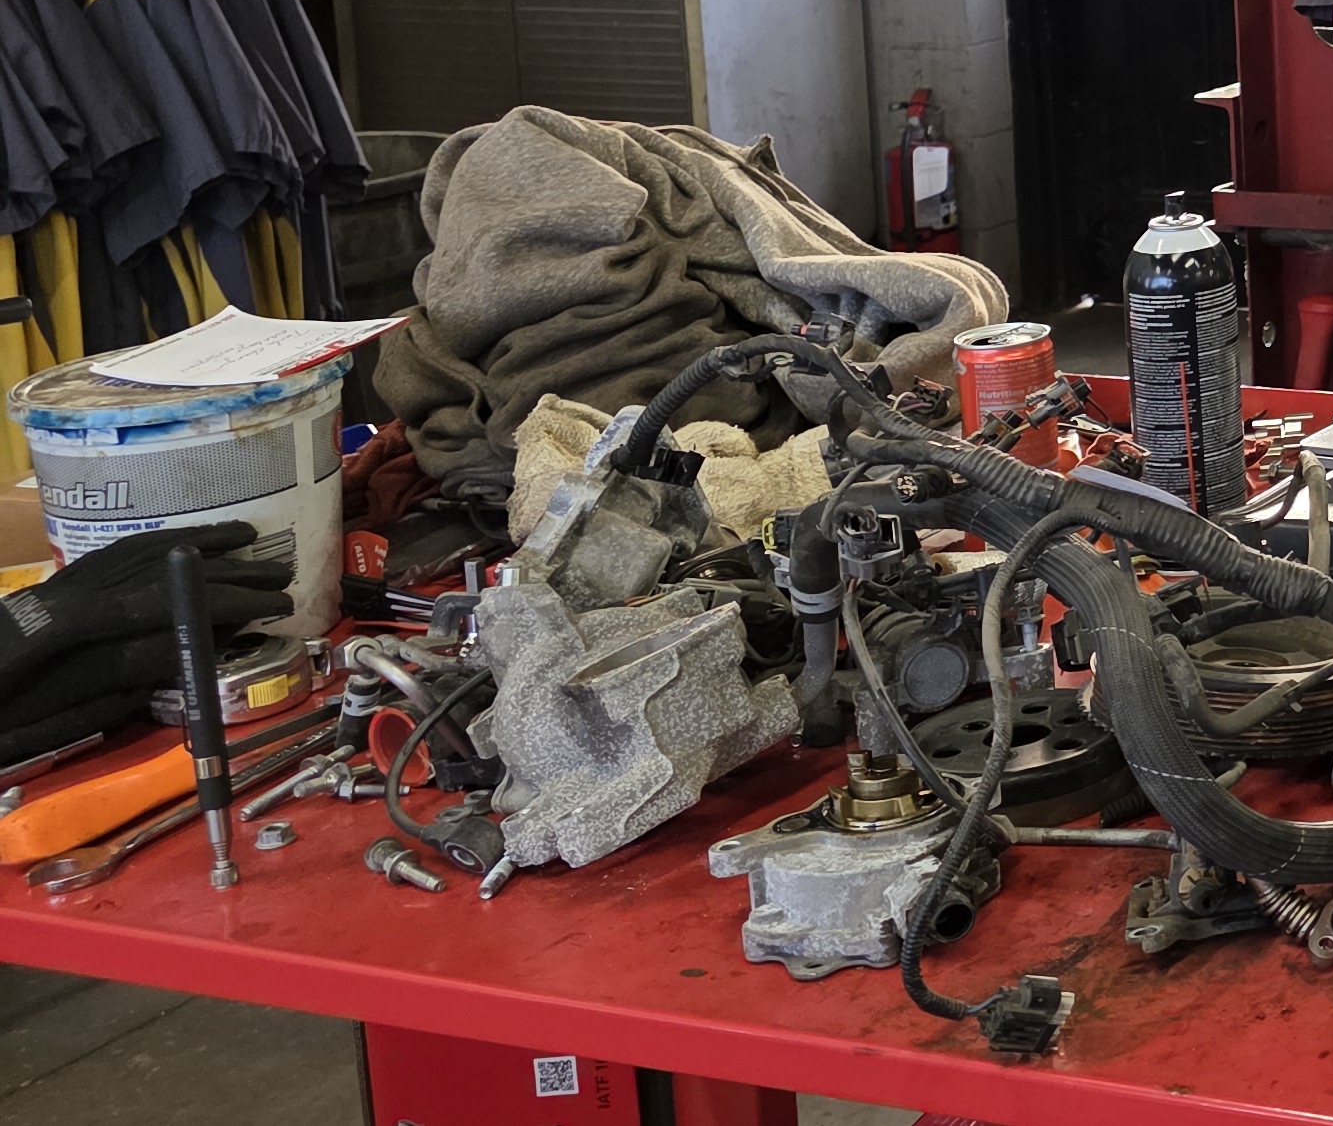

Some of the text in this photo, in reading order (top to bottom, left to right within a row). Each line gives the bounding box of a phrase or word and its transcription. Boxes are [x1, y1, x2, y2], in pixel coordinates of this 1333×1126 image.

[978, 389, 1025, 399] Nutrition
[39, 479, 130, 511] endall
[61, 521, 91, 532] Kendall
[116, 522, 142, 532] SUPER
[178, 624, 198, 706] ULLMAN HT-1
[595, 1075, 611, 1109] IATF
